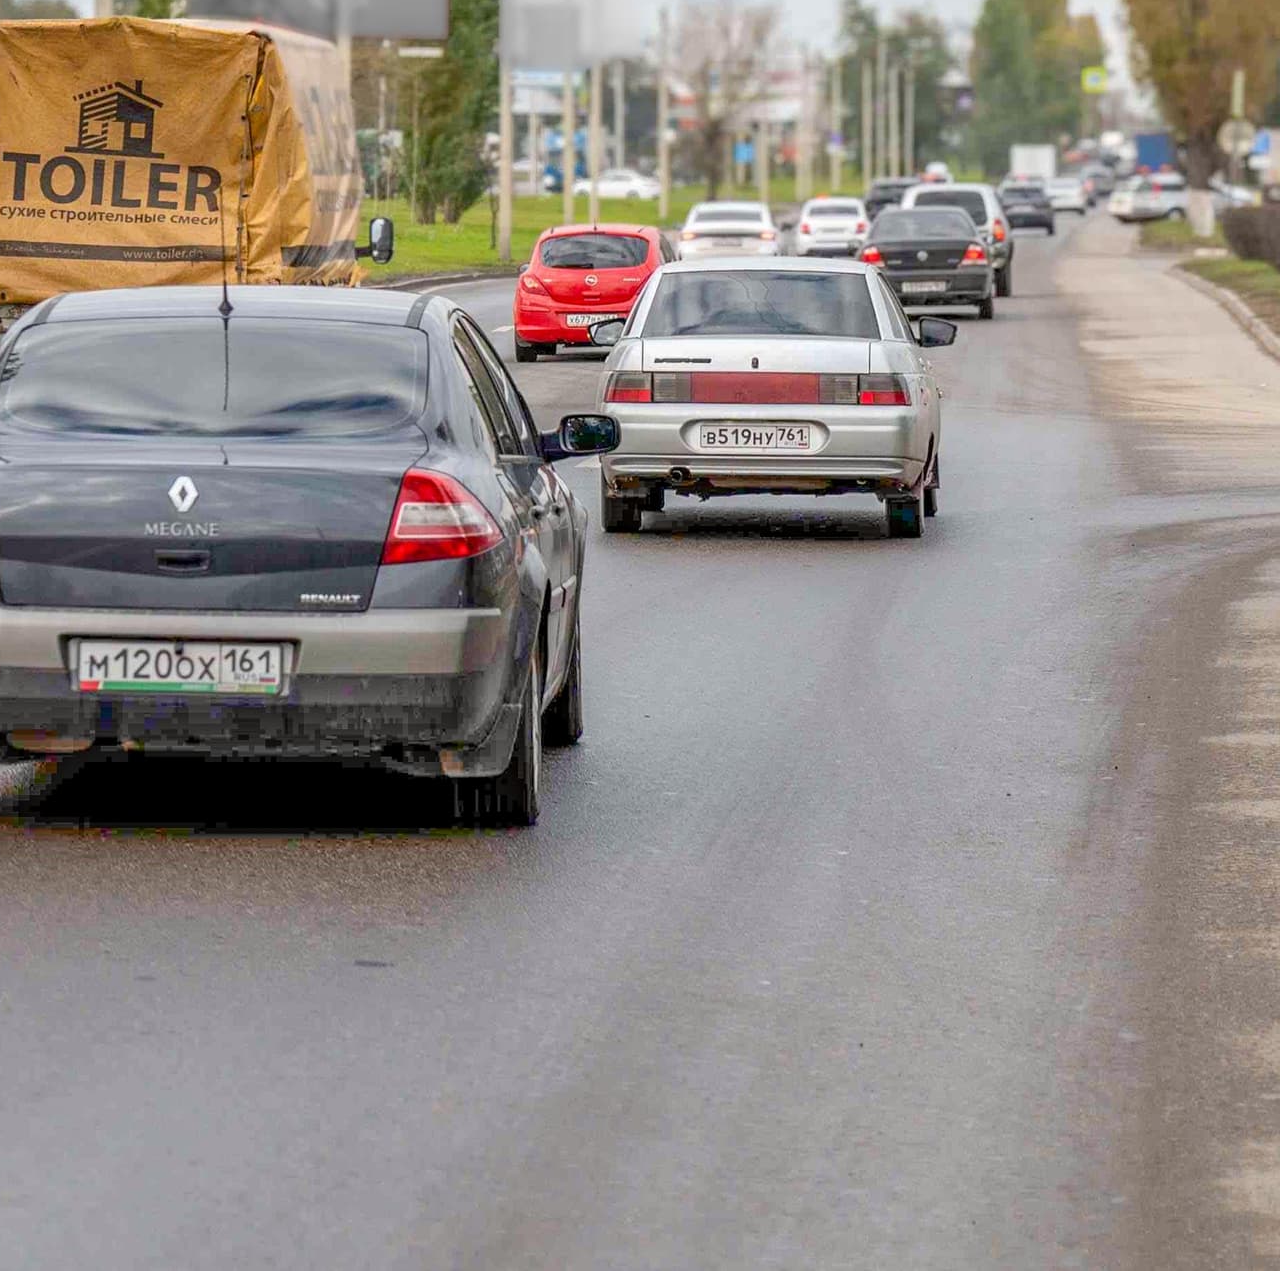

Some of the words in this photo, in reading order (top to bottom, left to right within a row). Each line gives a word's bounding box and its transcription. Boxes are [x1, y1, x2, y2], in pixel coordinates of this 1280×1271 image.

[3, 151, 222, 213] TOILER
[0, 205, 46, 220] сухие
[50, 208, 166, 224] строительные
[170, 215, 218, 226] смеси
[144, 522, 220, 537] MEGANE
[300, 593, 361, 603] RENAULT
[224, 649, 272, 673] 161
